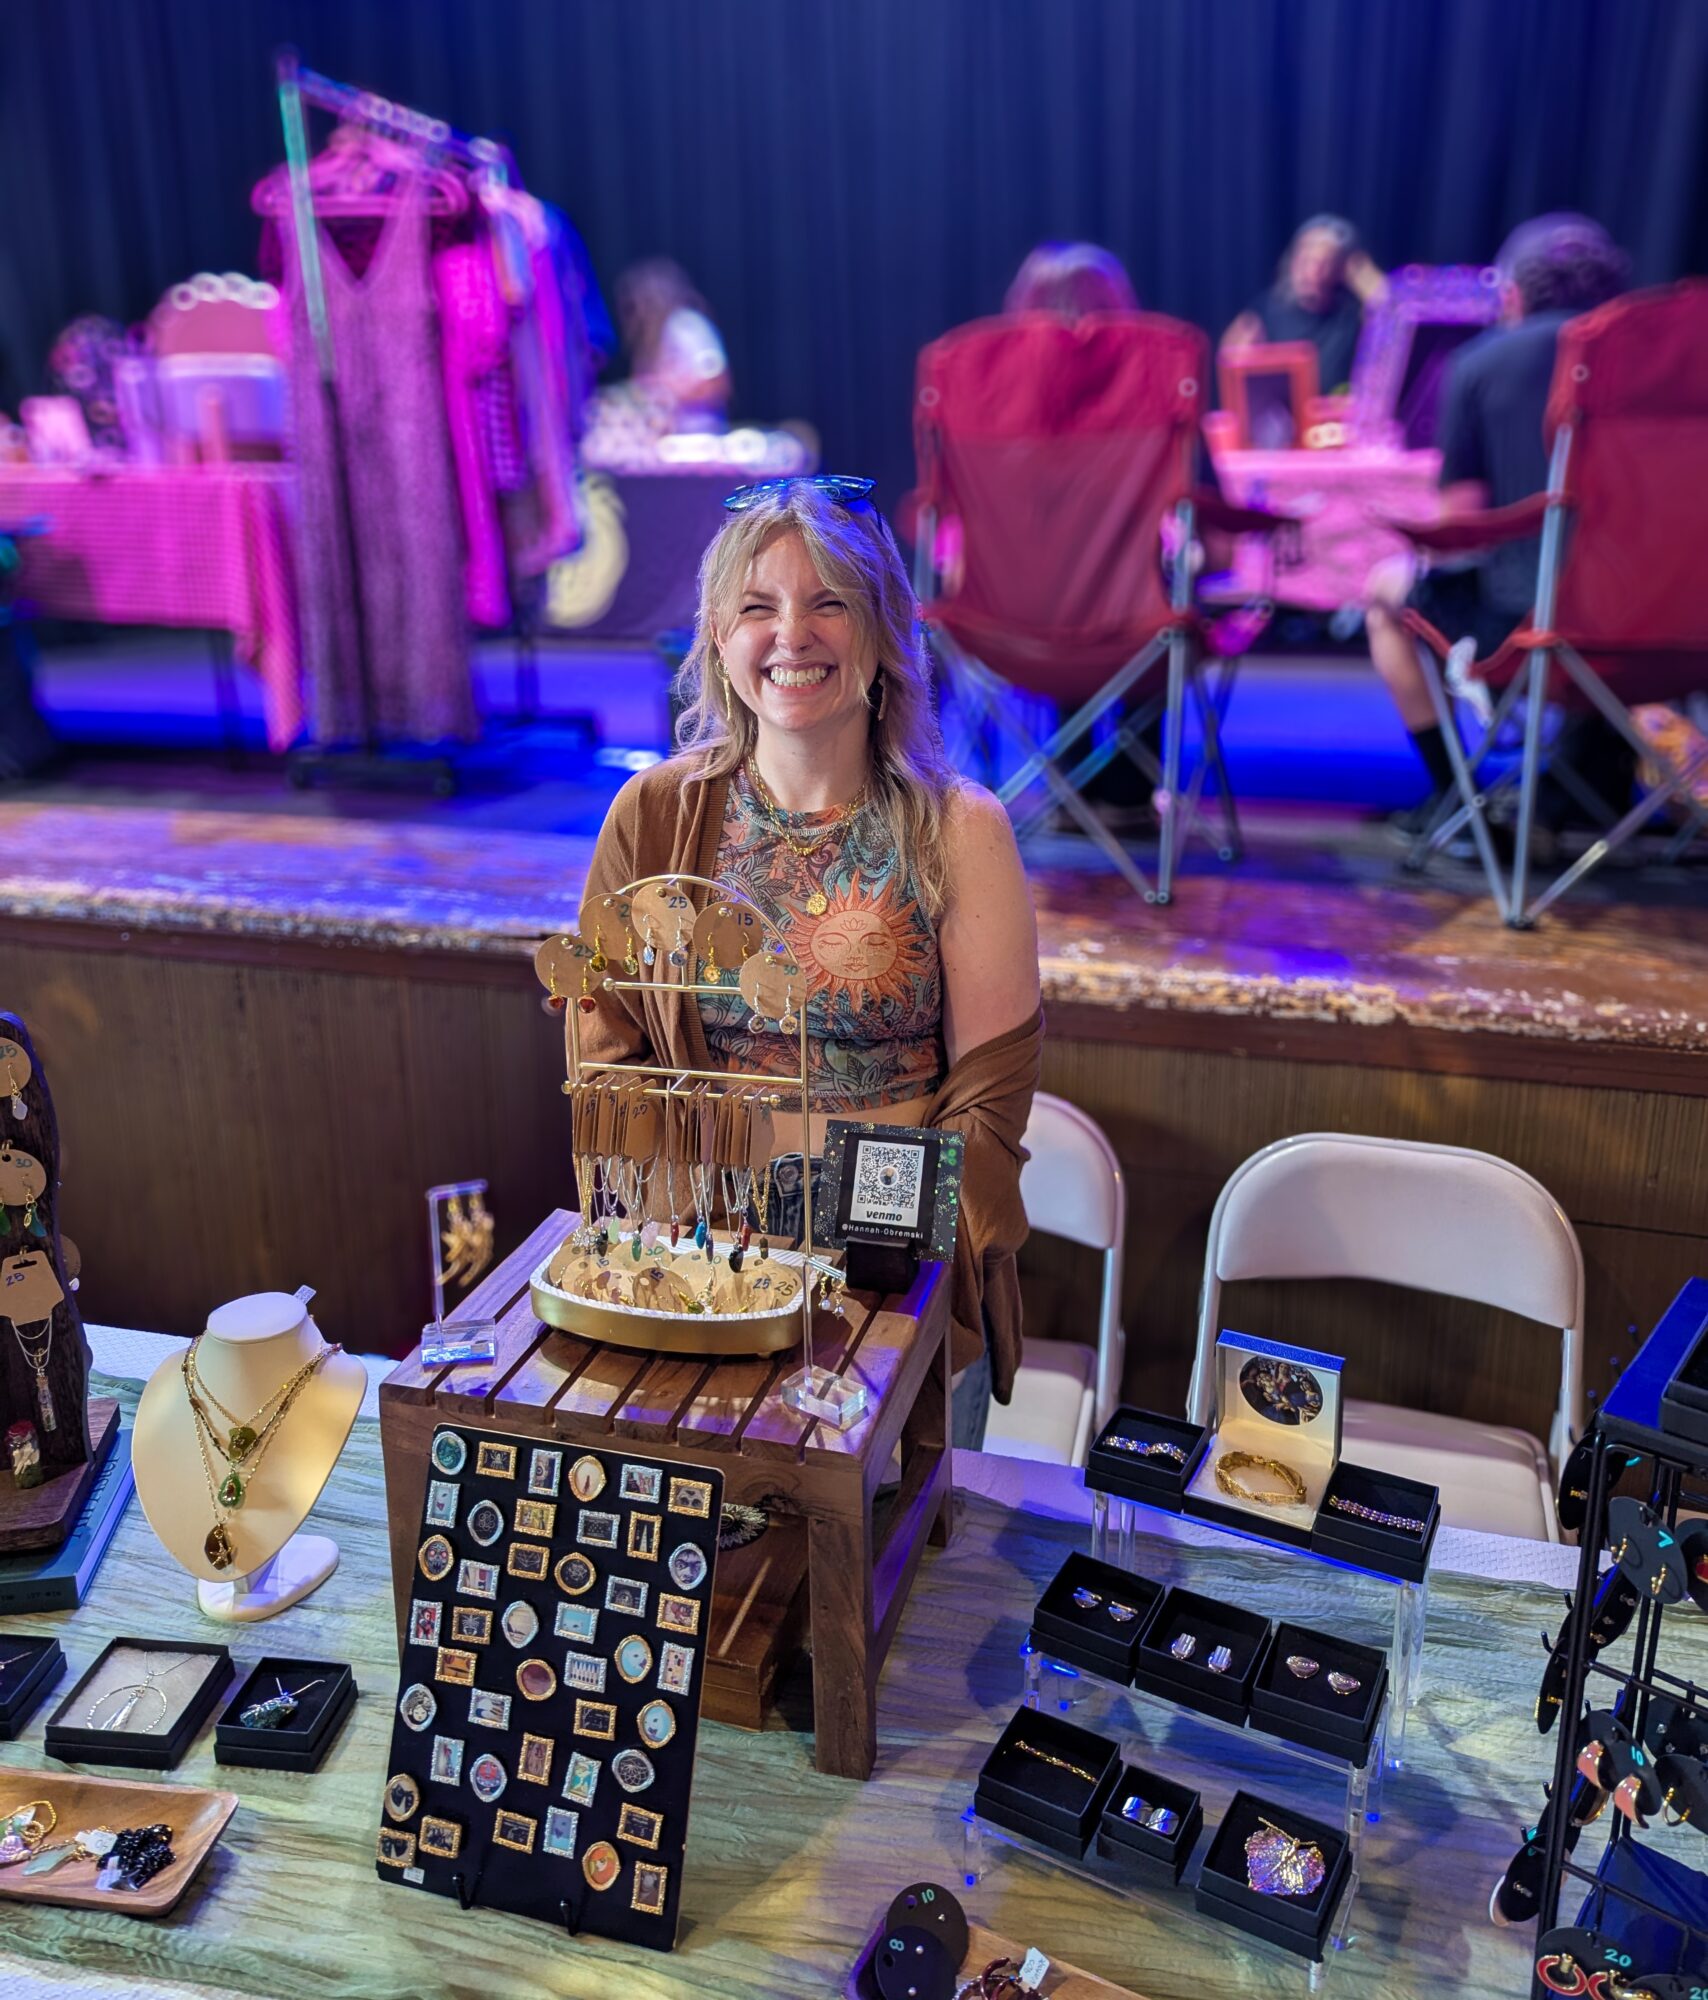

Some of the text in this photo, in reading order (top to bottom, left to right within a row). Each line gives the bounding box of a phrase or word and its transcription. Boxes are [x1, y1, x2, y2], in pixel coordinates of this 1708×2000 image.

[668, 895, 688, 909] 25
[620, 902, 632, 918] 2
[737, 912, 754, 927] 15
[784, 964, 799, 976] 30
[16, 1157, 33, 1168] 30
[866, 1209, 903, 1222] venmo
[841, 1223, 924, 1240] @Hannah-Obremski
[6, 1272, 25, 1287] 25
[753, 1277, 771, 1290] 25
[774, 1281, 794, 1297] 25
[1631, 1745, 1644, 1767] 10
[921, 1888, 936, 1904] 10
[1604, 1948, 1633, 1968] 20
